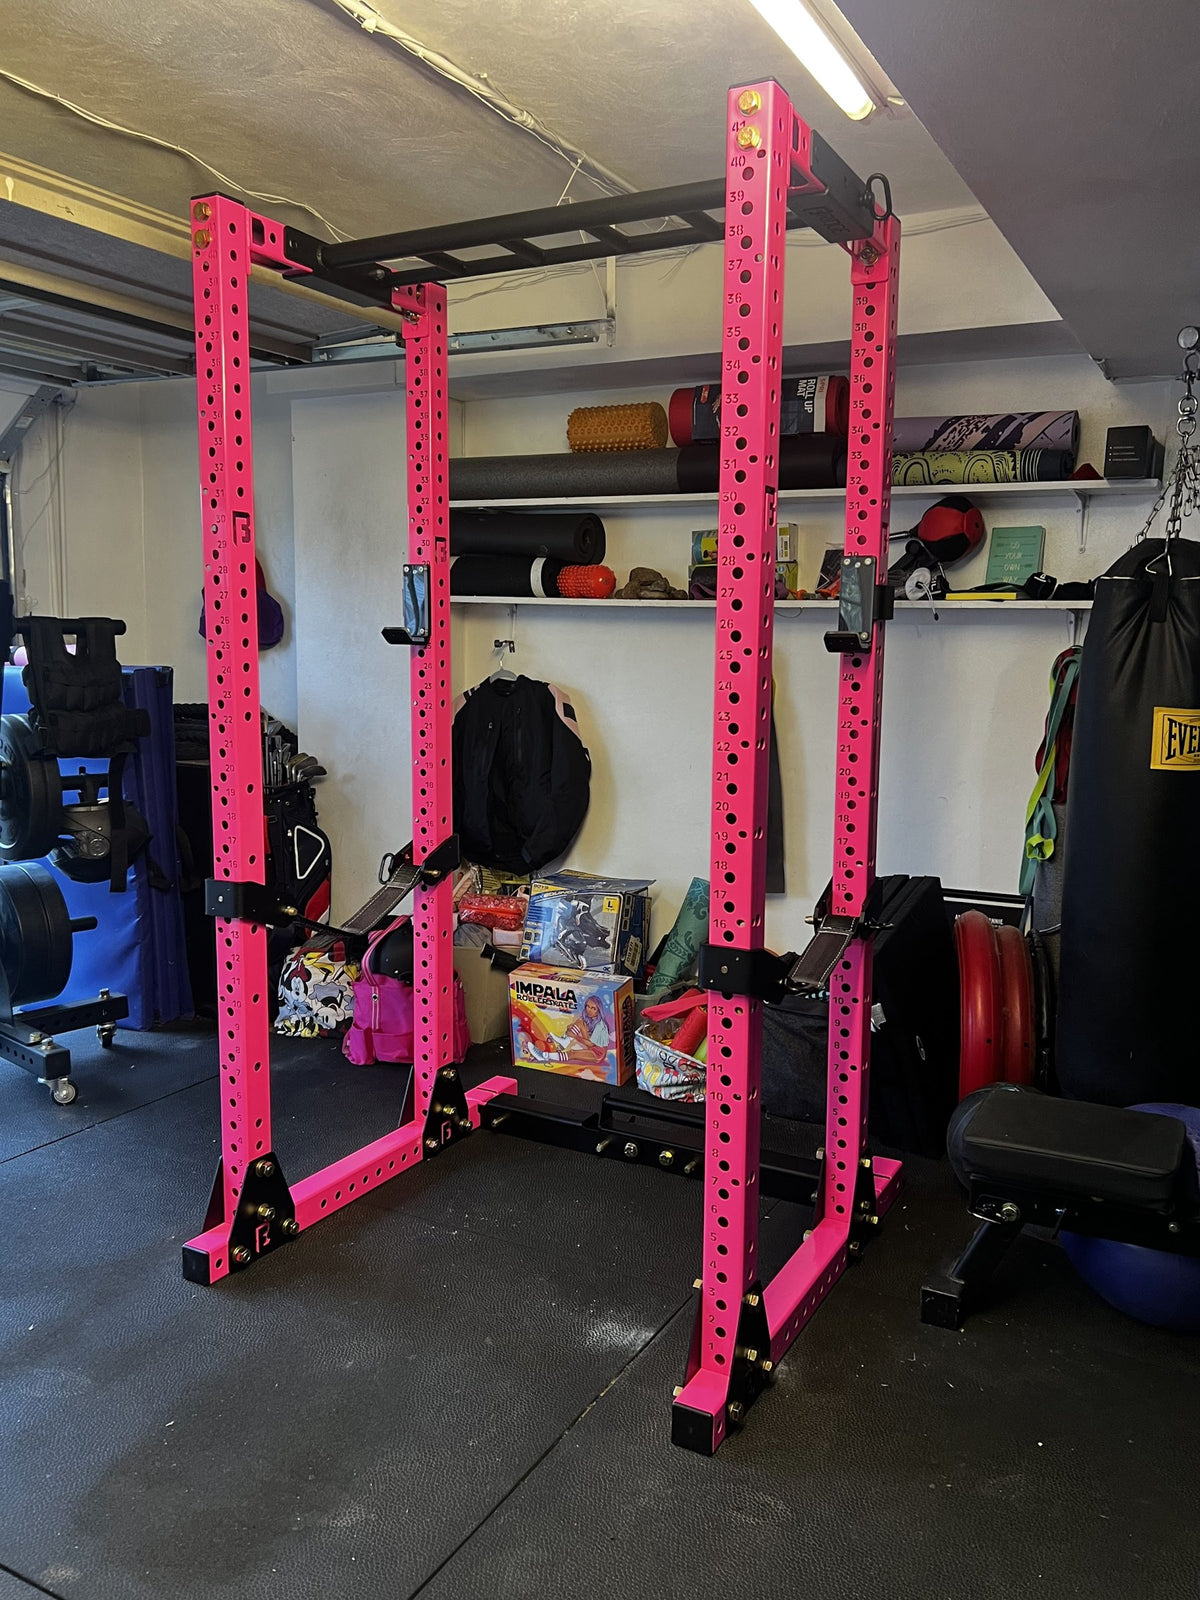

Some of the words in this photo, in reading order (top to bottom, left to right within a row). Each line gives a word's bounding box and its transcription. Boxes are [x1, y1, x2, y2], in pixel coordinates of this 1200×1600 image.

[730, 156, 745, 167] 40
[729, 191, 745, 202] 39
[728, 225, 744, 236] 38
[728, 259, 743, 270] 37
[727, 293, 742, 304] 36
[726, 327, 741, 338] 35
[854, 348, 867, 357] 37
[725, 360, 741, 371] 34
[853, 374, 866, 383] 36
[212, 385, 221, 393] 35
[797, 379, 807, 397] MAT
[804, 378, 816, 399] ROLL
[725, 393, 739, 403] 33
[804, 400, 814, 413] UP
[852, 400, 864, 409] 35
[724, 427, 739, 437] 32
[851, 425, 864, 434] 34
[214, 437, 223, 445] 33
[851, 451, 862, 460] 33
[214, 463, 224, 472] 32
[723, 459, 737, 469] 31
[850, 477, 862, 485] 32
[215, 489, 225, 497] 31
[723, 491, 737, 502] 30
[848, 501, 860, 510] 31
[216, 515, 226, 523] 30
[722, 524, 737, 534] 29
[217, 540, 227, 549] 29
[421, 539, 431, 547] 30
[721, 556, 736, 566] 28
[218, 566, 228, 574] 28
[219, 591, 228, 599] 27
[721, 588, 735, 598] 27
[220, 616, 230, 624] 26
[720, 619, 734, 629] 26
[221, 641, 231, 649] 25
[719, 650, 733, 660] 25
[843, 673, 854, 682] 24
[718, 681, 733, 691] 24
[223, 691, 232, 699] 23
[841, 697, 853, 705] 23
[717, 712, 731, 721] 23
[840, 721, 853, 729] 22
[1165, 717, 1200, 760] EVE
[224, 740, 233, 748] 21
[716, 742, 730, 752] 22
[840, 745, 851, 753] 21
[225, 764, 235, 772] 20
[839, 768, 851, 776] 20
[716, 772, 729, 782] 21
[838, 791, 850, 800] 19
[715, 802, 729, 811] 20
[838, 815, 849, 823] 18
[228, 836, 237, 844] 17
[715, 832, 728, 841] 19
[837, 837, 849, 845] 17
[228, 860, 238, 868] 16
[714, 861, 728, 870] 18
[836, 883, 847, 891] 15
[713, 890, 727, 899] 17
[607, 900, 613, 908] L
[835, 906, 846, 914] 14
[713, 919, 726, 928] 16
[231, 931, 239, 939] 13
[232, 954, 240, 962] 12
[833, 974, 845, 982] 11
[515, 981, 578, 1003] IMPALA
[833, 997, 844, 1005] 10
[712, 1006, 724, 1015] 13
[235, 1023, 240, 1031] 9
[834, 1019, 841, 1027] 9
[711, 1035, 724, 1044] 12
[834, 1041, 840, 1049] 8
[710, 1063, 723, 1072] 11
[832, 1086, 839, 1094] 6
[710, 1092, 723, 1102] 10
[832, 1108, 839, 1116] 5
[237, 1114, 242, 1122] 5
[712, 1120, 719, 1129] 9
[831, 1130, 838, 1138] 4
[712, 1149, 719, 1158] 8
[831, 1151, 837, 1159] 3
[712, 1176, 718, 1185] 7
[711, 1204, 717, 1214] 6
[710, 1233, 717, 1242] 5
[709, 1260, 716, 1269] 4
[709, 1288, 715, 1296] 3
[708, 1315, 715, 1323] 2
[709, 1342, 714, 1350] 1
